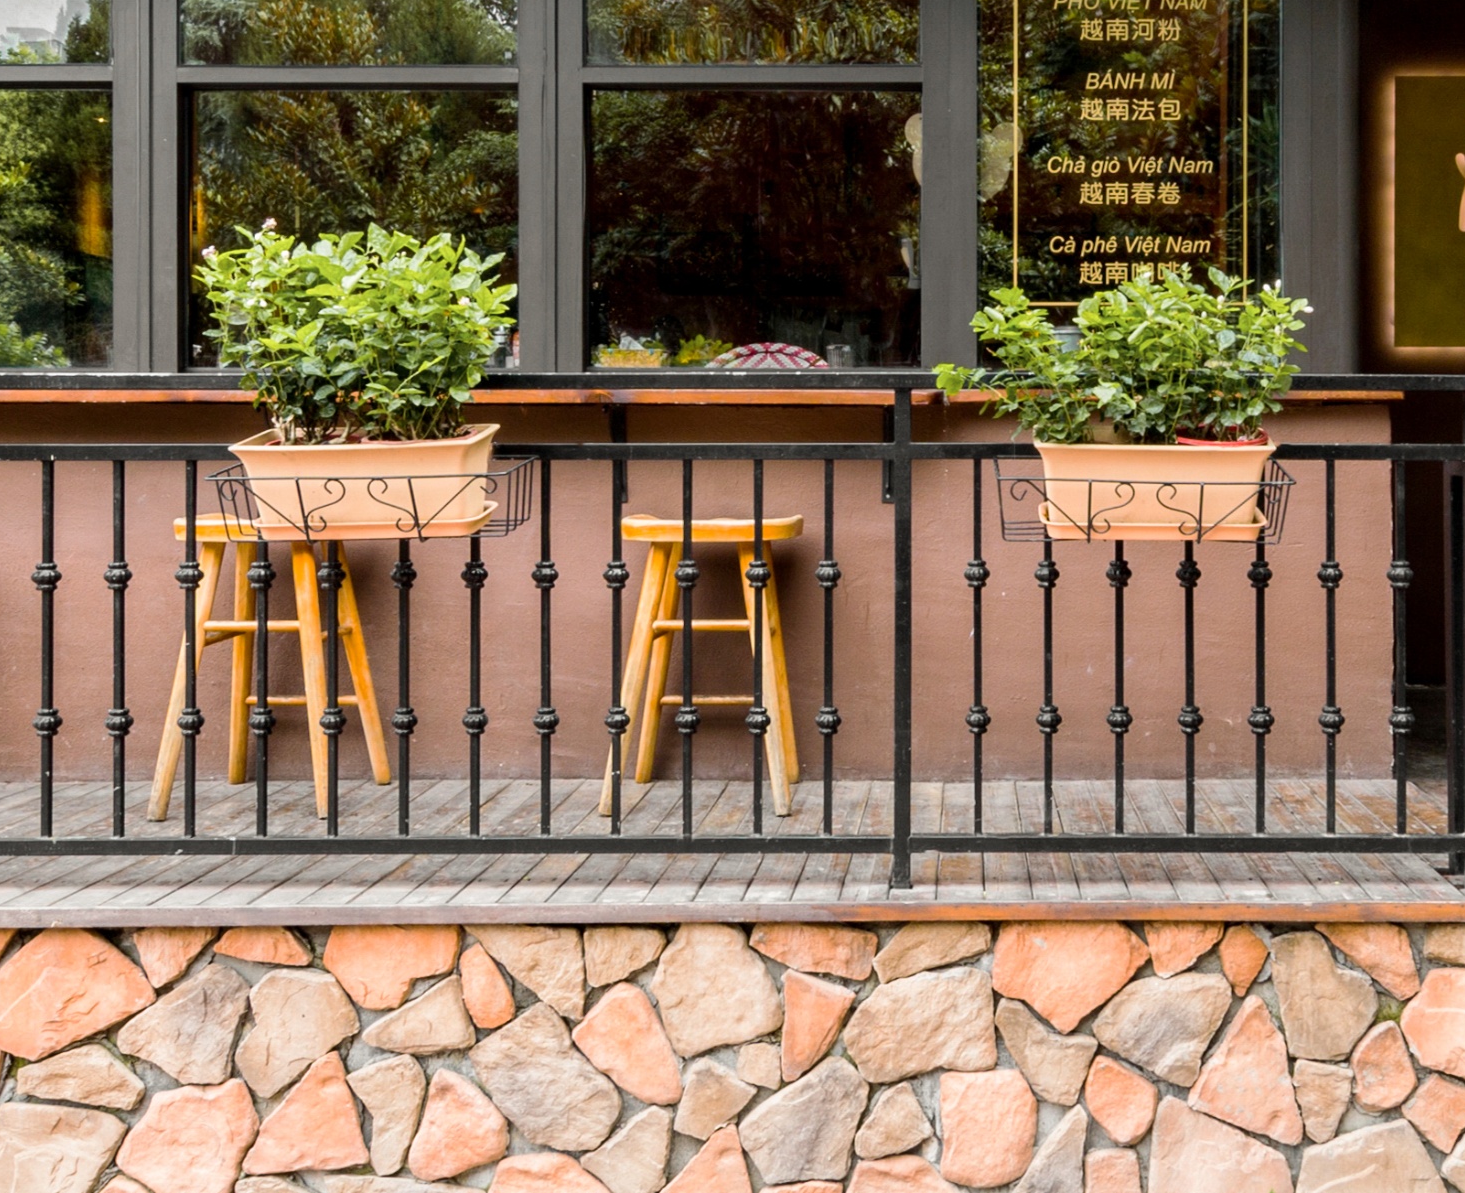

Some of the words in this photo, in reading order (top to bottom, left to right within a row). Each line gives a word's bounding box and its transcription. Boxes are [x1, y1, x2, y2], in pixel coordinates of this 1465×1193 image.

[1080, 18, 1182, 42] 越南河粉
[1086, 69, 1145, 90] BÁNH
[1150, 69, 1176, 90] MÌ
[1080, 97, 1182, 121] 越南法包
[1047, 155, 1086, 174] Chả
[1091, 156, 1121, 177] giò
[1127, 156, 1163, 177] Việt
[1168, 157, 1214, 174] Nam
[1079, 181, 1182, 205] 越南春卷
[1049, 235, 1076, 254] Cà
[1080, 236, 1119, 257] phê
[1124, 236, 1161, 257] Việt
[1165, 236, 1211, 254] Nam
